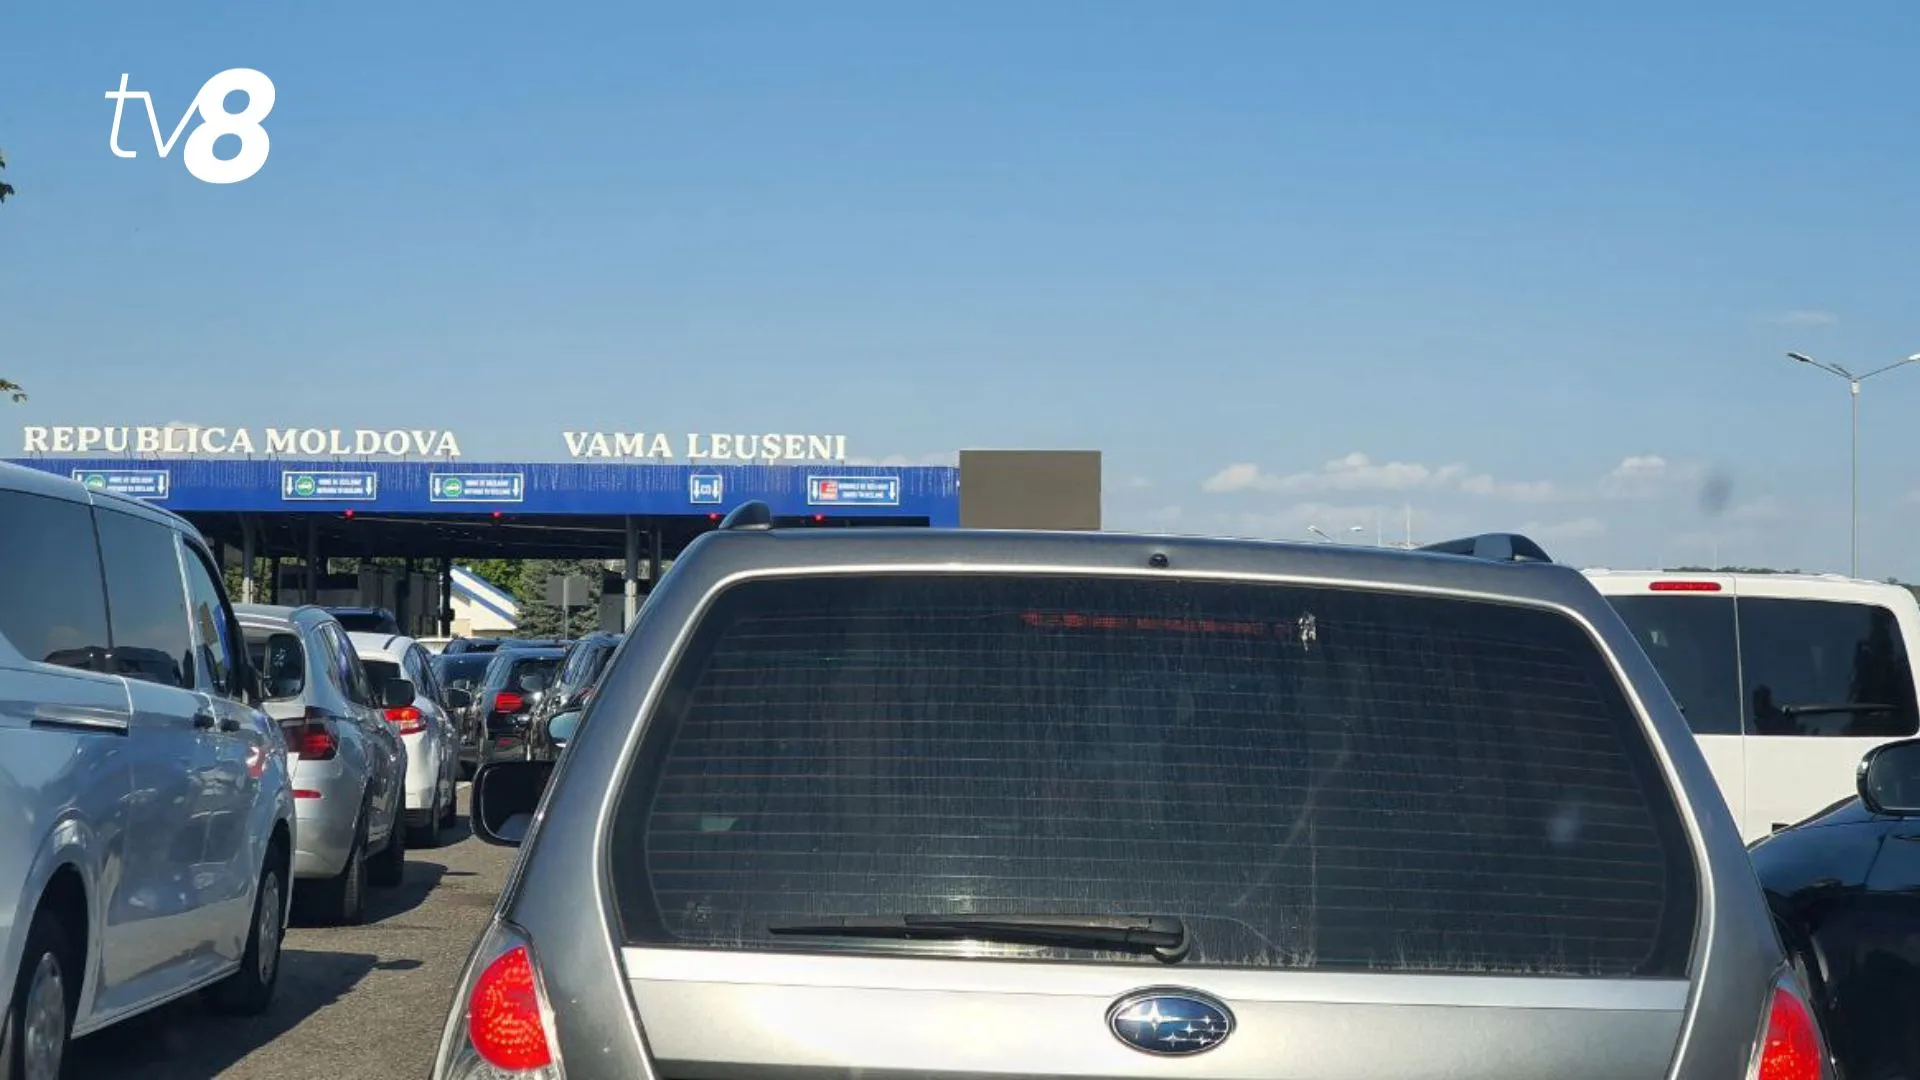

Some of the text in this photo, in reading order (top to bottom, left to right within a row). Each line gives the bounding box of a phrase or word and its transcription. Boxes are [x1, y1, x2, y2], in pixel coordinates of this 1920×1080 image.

[23, 426, 461, 457] REPUBLICA MOLDOVA
[563, 431, 674, 458] VAMA
